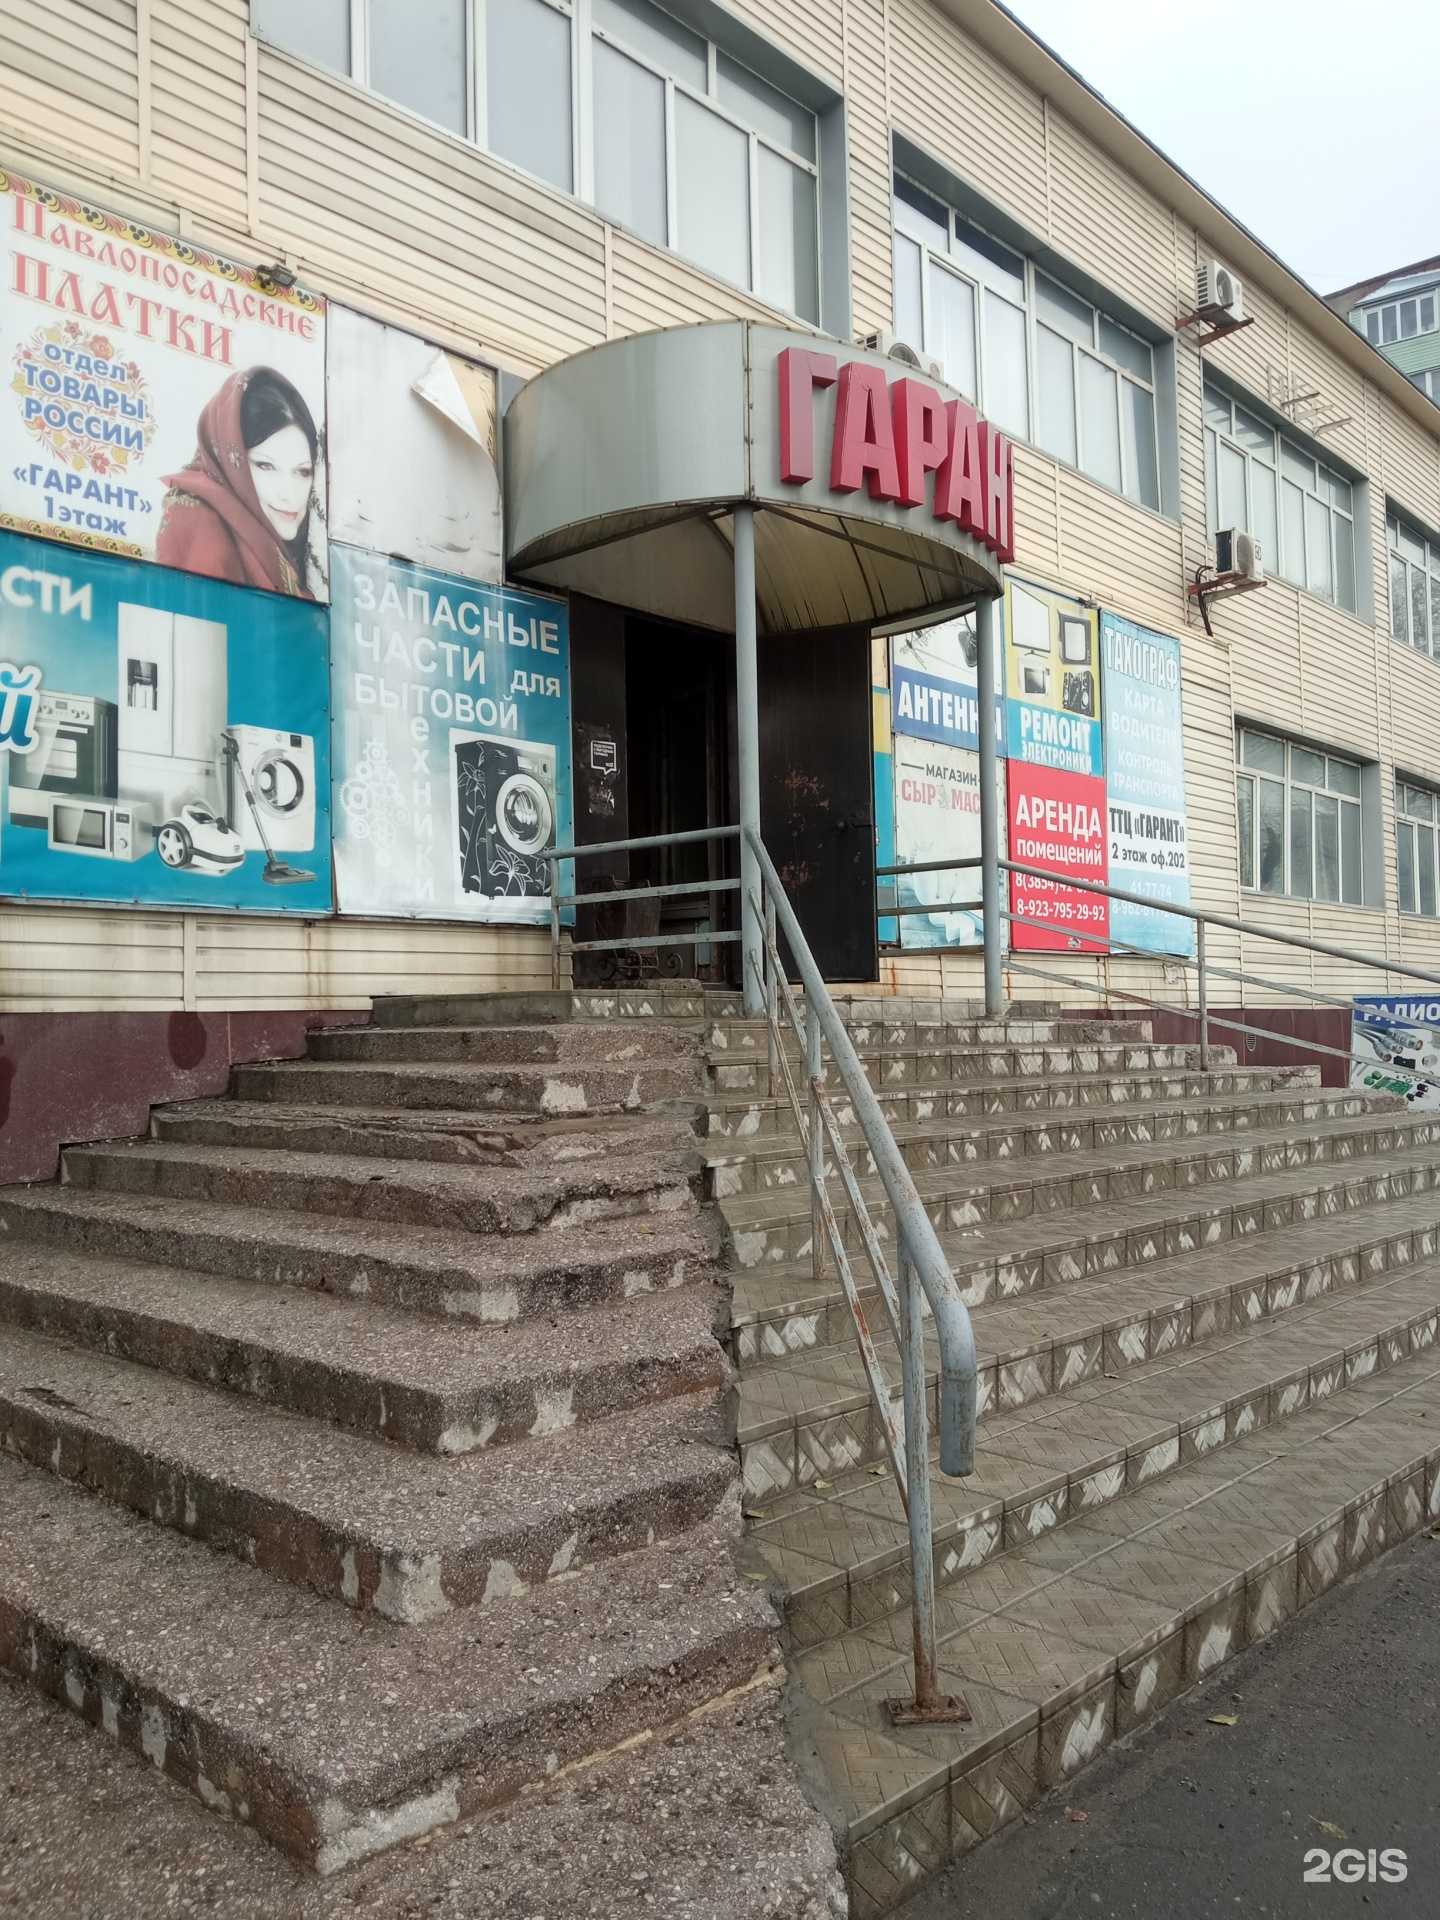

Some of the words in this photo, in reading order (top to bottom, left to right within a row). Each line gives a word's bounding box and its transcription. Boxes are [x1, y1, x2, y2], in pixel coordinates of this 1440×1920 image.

[9, 250, 233, 365] ПЛАТКИ
[44, 343, 126, 382] отдел
[23, 364, 145, 420] ТОВАРЫ
[25, 398, 144, 452] РОССИИ
[13, 463, 153, 514] «ГАРАНТ»
[353, 574, 560, 655] ЗАПАСНЫЕ
[355, 622, 486, 685] ЧАСТИ
[510, 670, 561, 698] для
[1104, 627, 1178, 690] ТАХОГРАФ
[354, 673, 518, 731] БЫТОВОЙ
[1020, 707, 1091, 750] РЕМОНТ
[926, 764, 977, 786] МАГАЗИН
[1022, 741, 1092, 774] ЭЛЕКТРОНИКИ
[901, 779, 936, 805] СЫР
[1016, 794, 1102, 843] АРЕНДА
[1109, 807, 1132, 839] ТТЦ
[1017, 838, 1102, 866] помещений
[1112, 843, 1118, 859] 2
[1122, 849, 1147, 864] этаж
[1151, 852, 1185, 869] оф.202
[1017, 898, 1105, 920] 8-923-795-29-92
